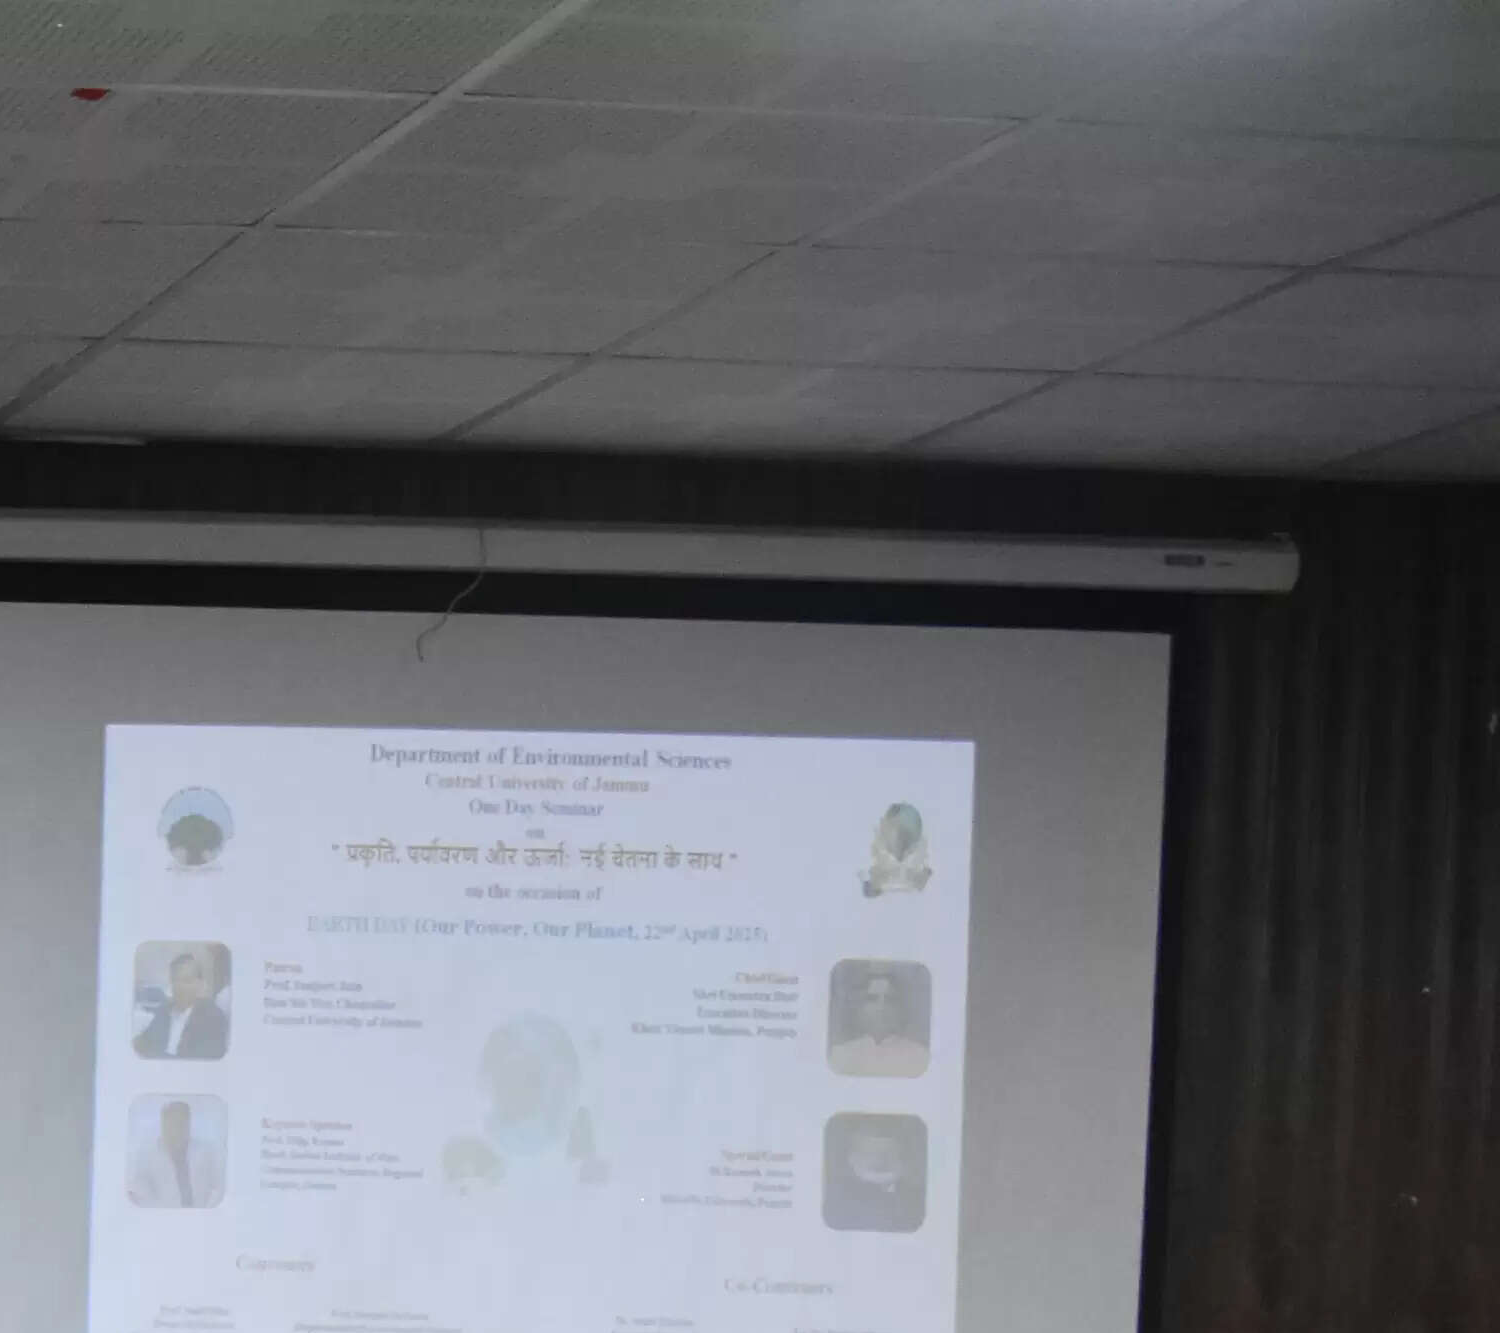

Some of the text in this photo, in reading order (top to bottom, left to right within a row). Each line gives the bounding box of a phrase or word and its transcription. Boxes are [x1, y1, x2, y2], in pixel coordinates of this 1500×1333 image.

[371, 744, 732, 769] Department of Environmental Sciences
[572, 776, 589, 791] of
